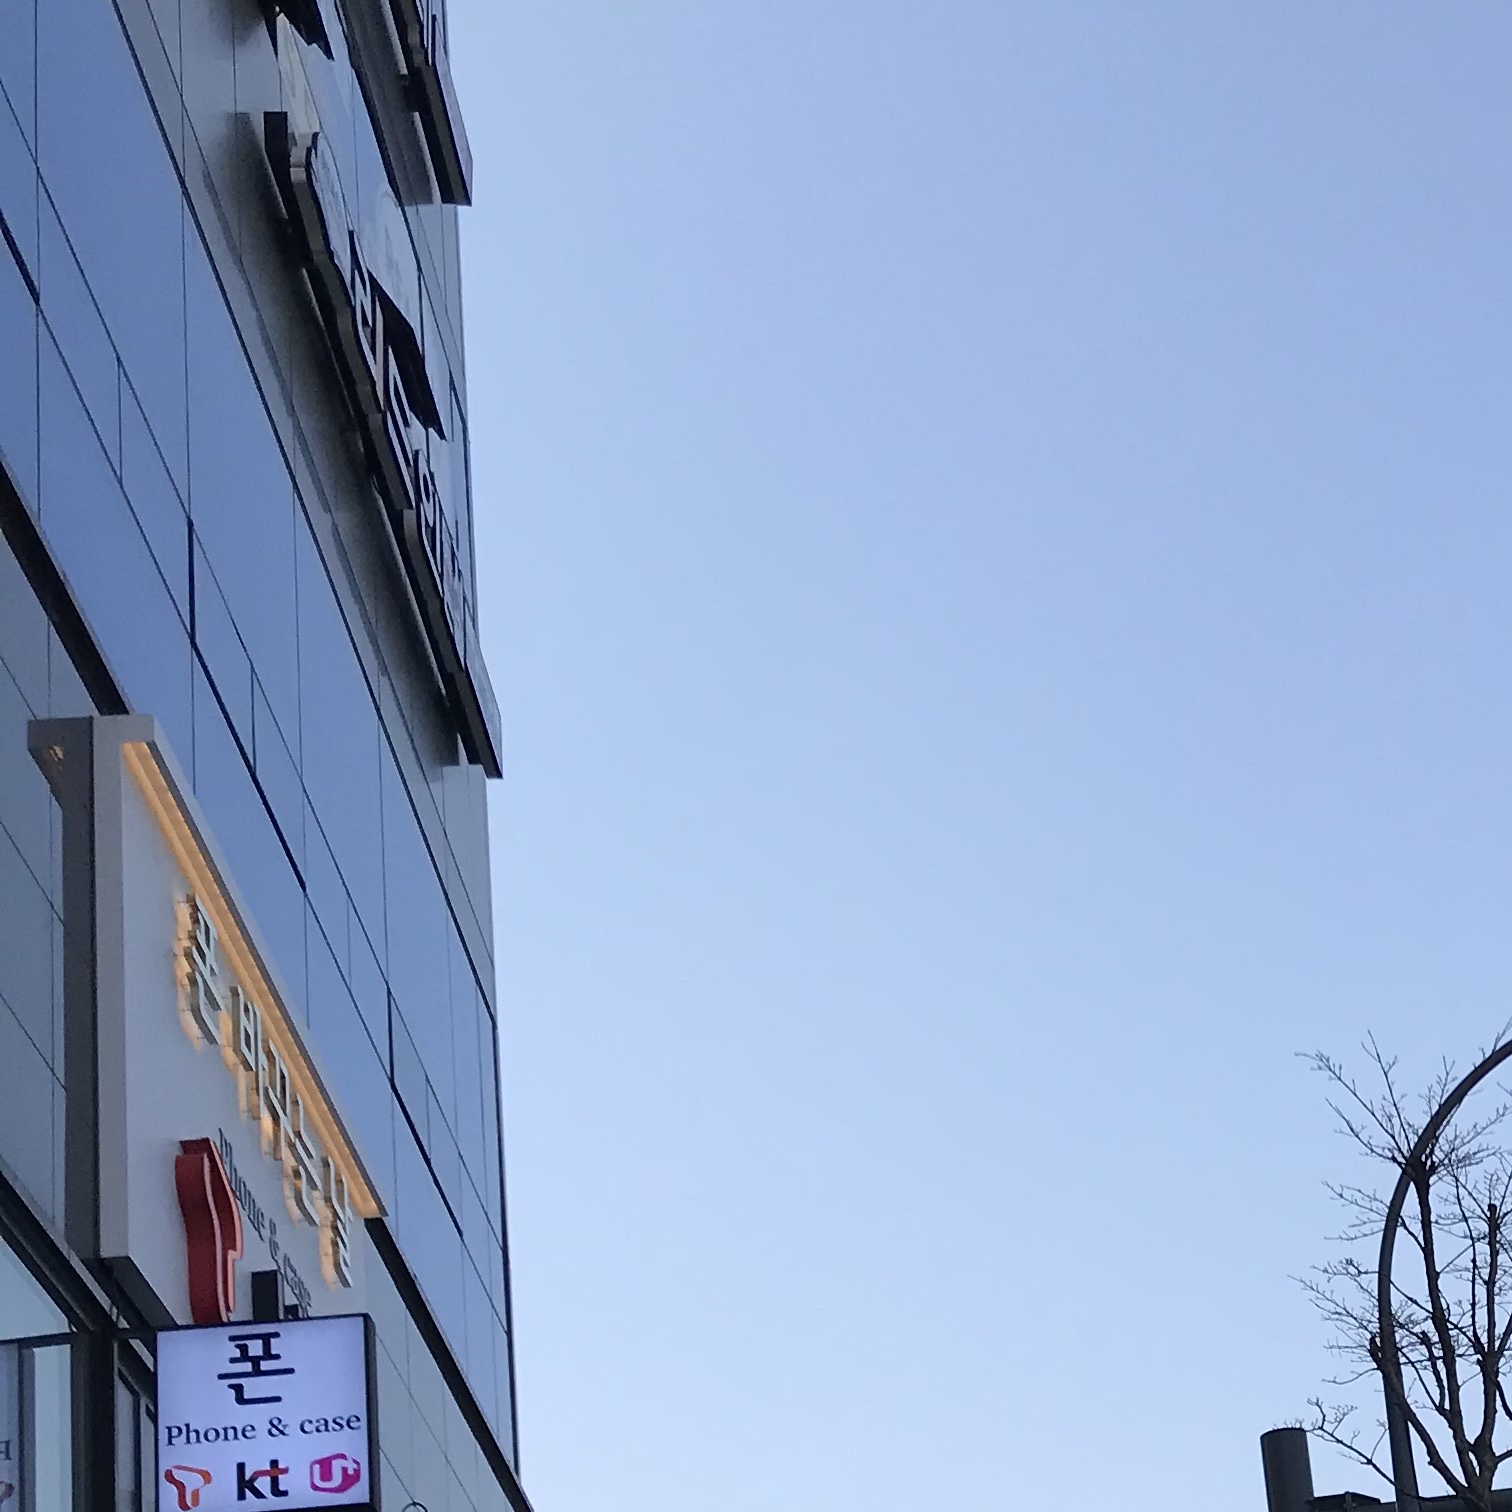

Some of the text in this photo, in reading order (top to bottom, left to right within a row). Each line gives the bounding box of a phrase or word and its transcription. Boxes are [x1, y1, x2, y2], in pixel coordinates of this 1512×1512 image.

[188, 892, 223, 1047] 폰
[218, 1332, 295, 1406] 폰
[165, 1413, 362, 1447] Phone & case
[236, 1459, 289, 1501] kt
